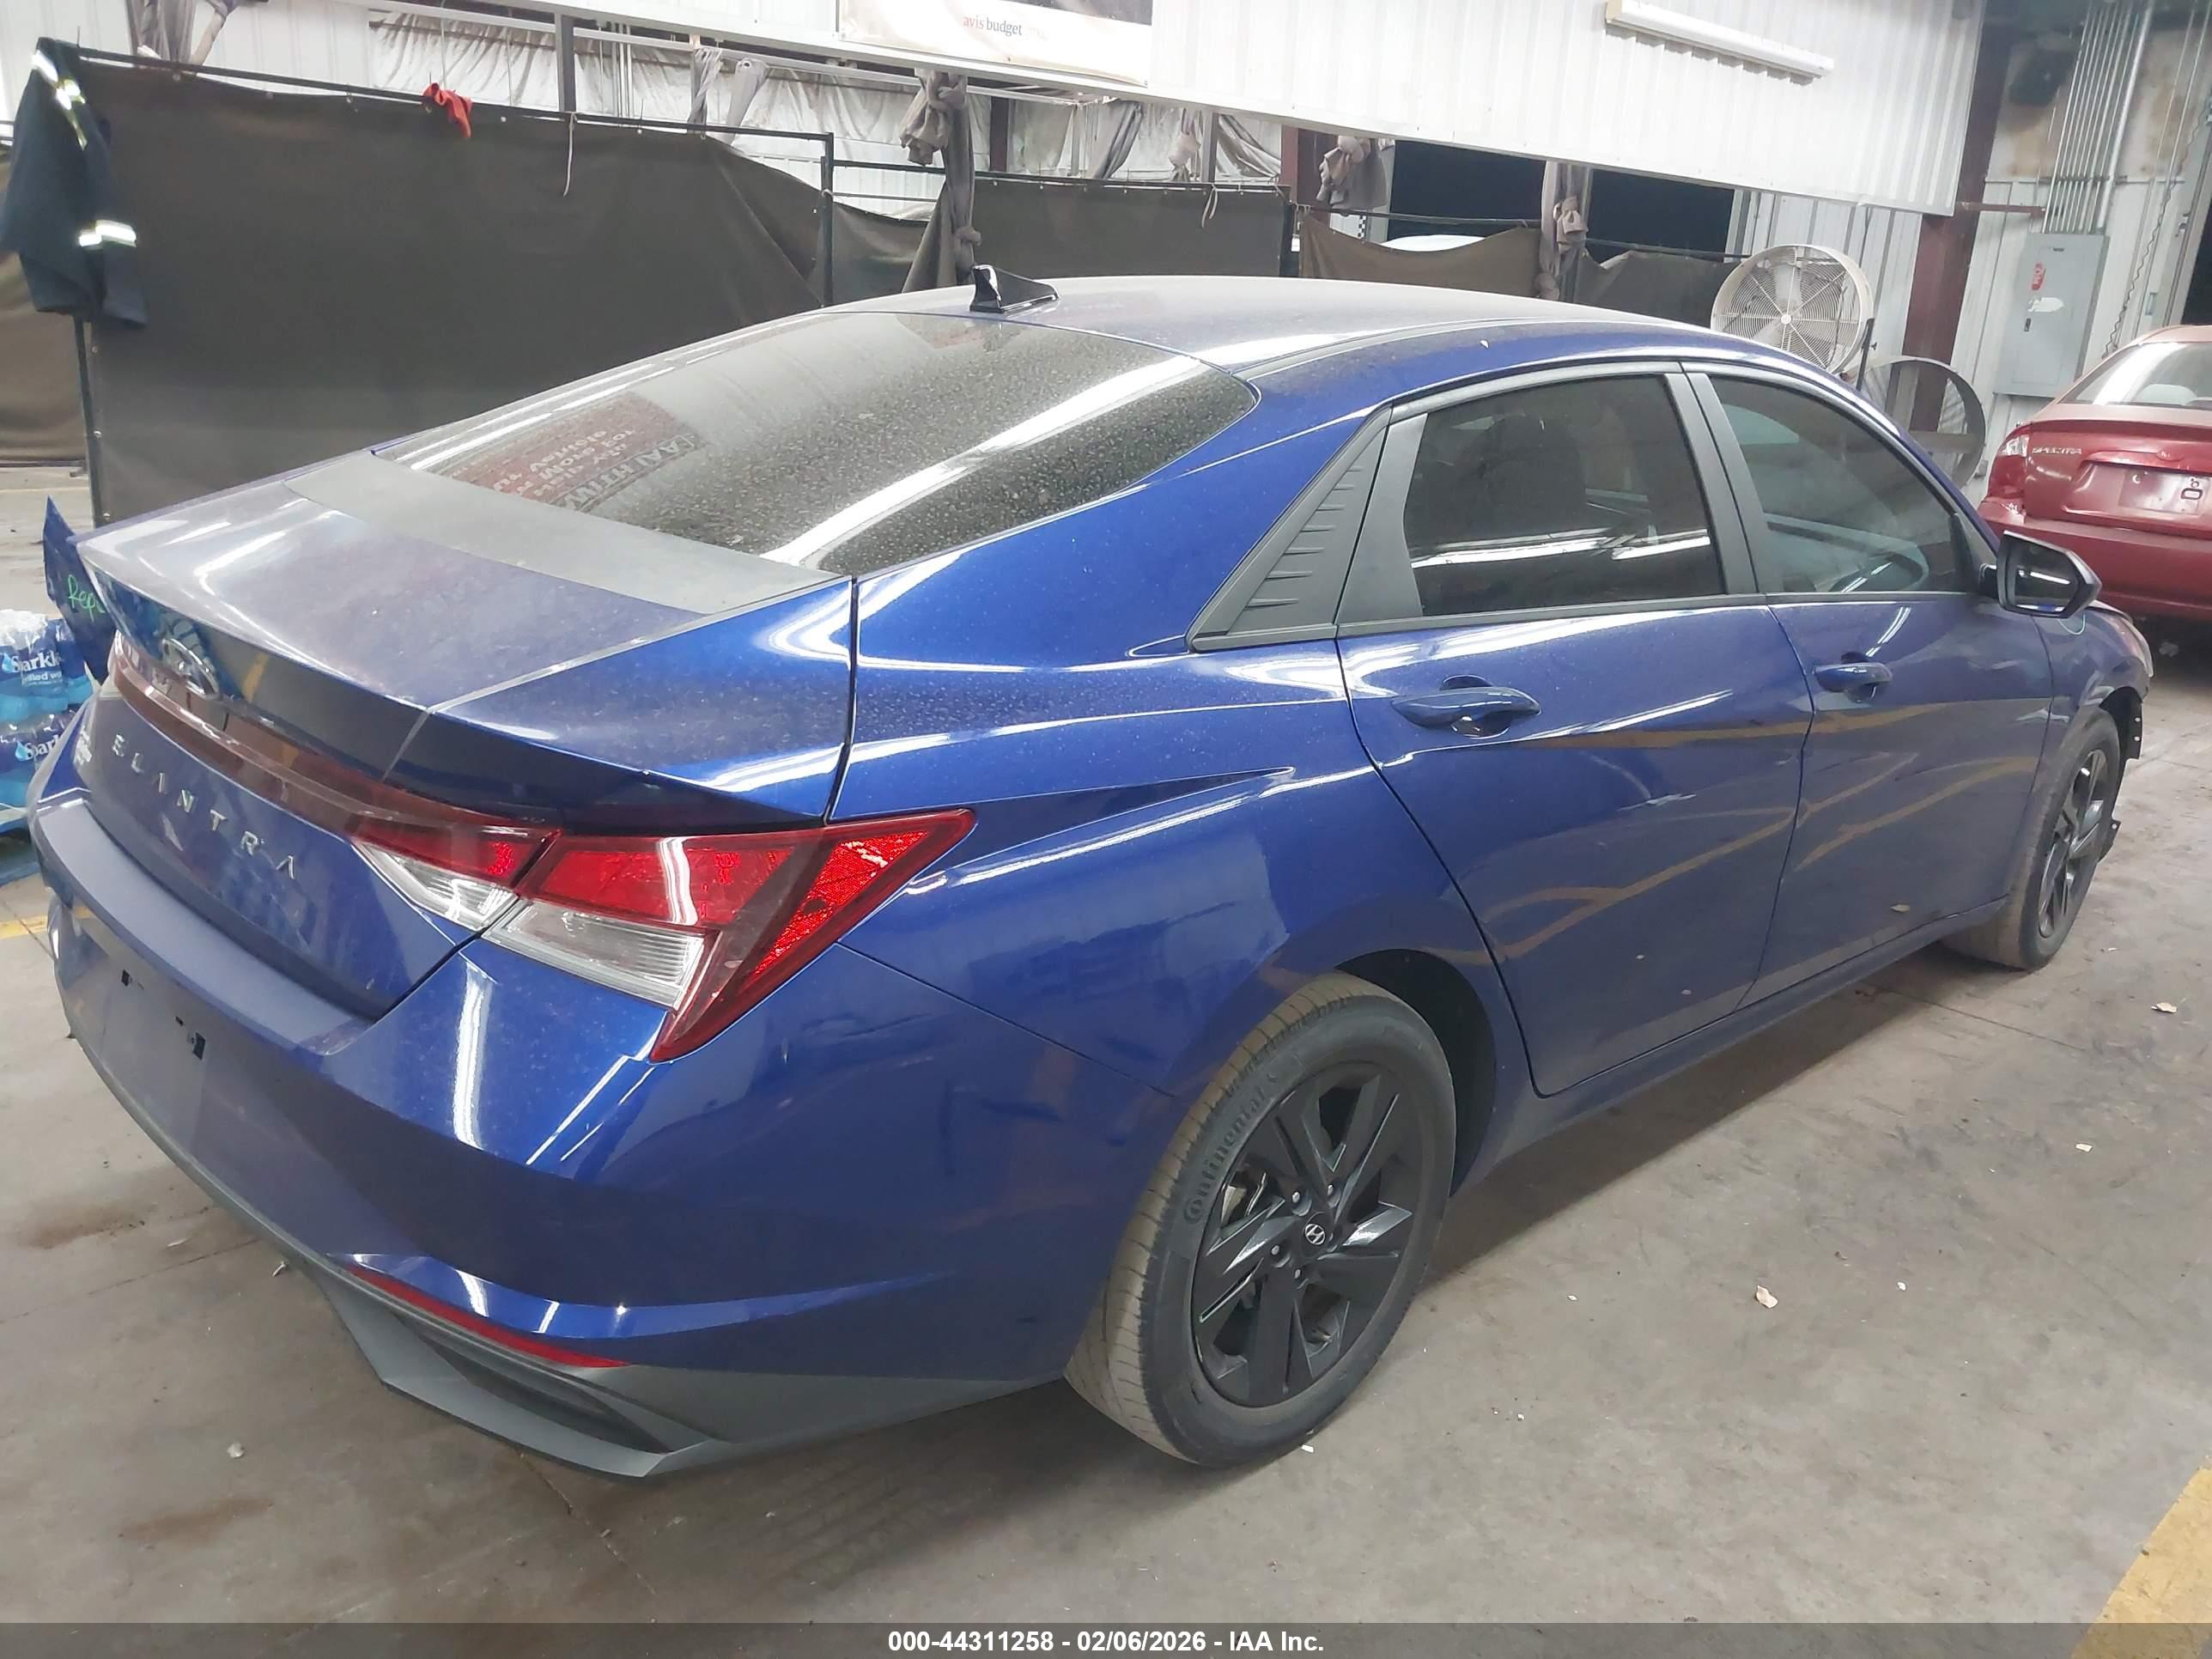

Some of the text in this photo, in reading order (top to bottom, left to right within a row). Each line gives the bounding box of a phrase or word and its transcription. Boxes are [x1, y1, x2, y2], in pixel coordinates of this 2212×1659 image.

[963, 15, 984, 29] avis
[986, 16, 1023, 37] budget
[112, 733, 296, 881] ELANTRA
